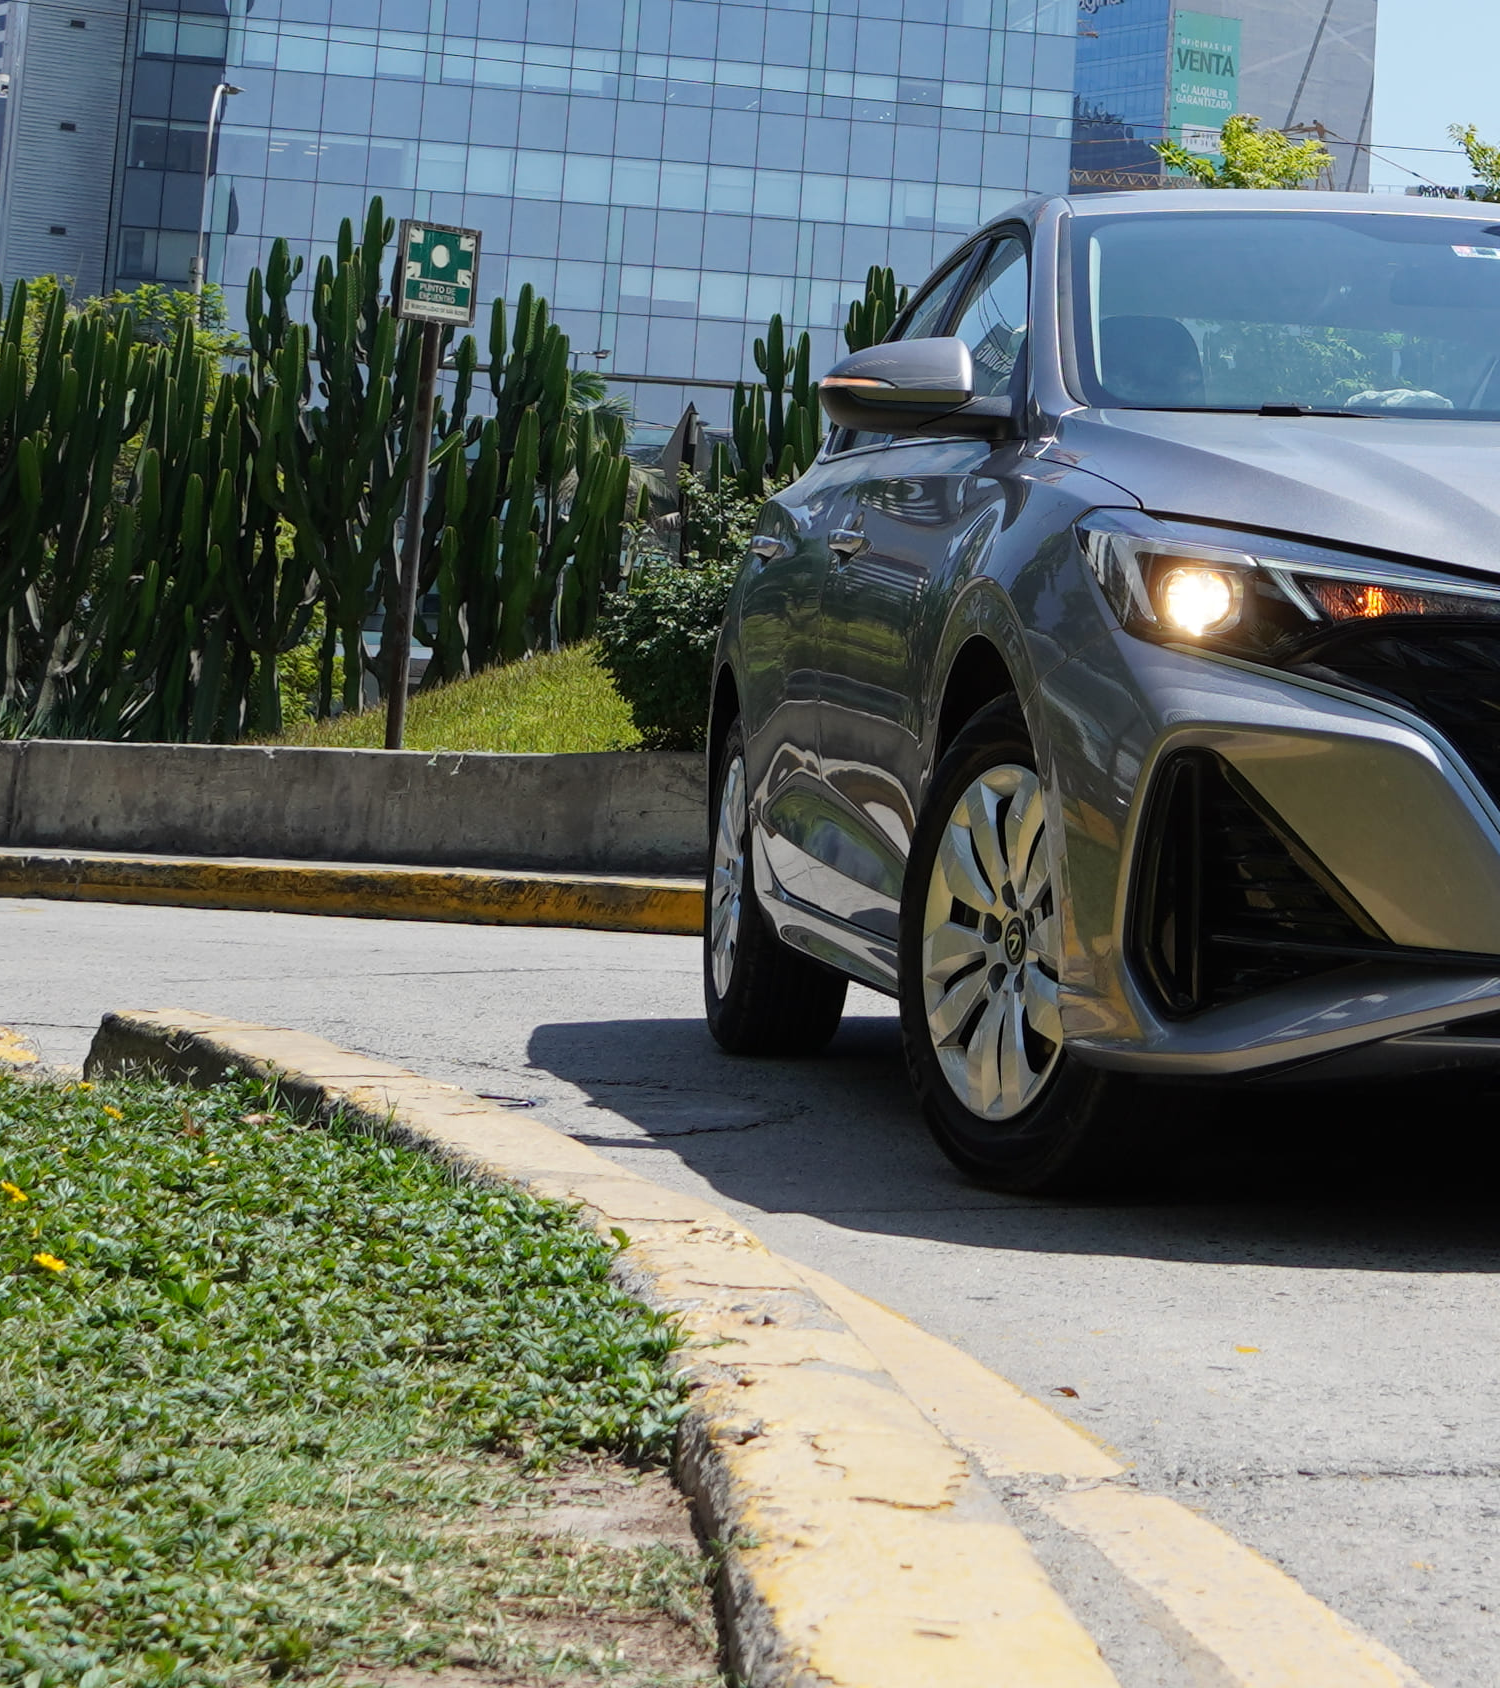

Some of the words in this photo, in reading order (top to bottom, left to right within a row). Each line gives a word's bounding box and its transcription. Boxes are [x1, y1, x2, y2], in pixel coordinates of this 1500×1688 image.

[1177, 47, 1235, 78] VENTA
[1191, 84, 1229, 100] ALQUILER
[1175, 93, 1232, 111] GARANTIZADO
[419, 283, 445, 294] PUNTO
[446, 287, 457, 296] DE
